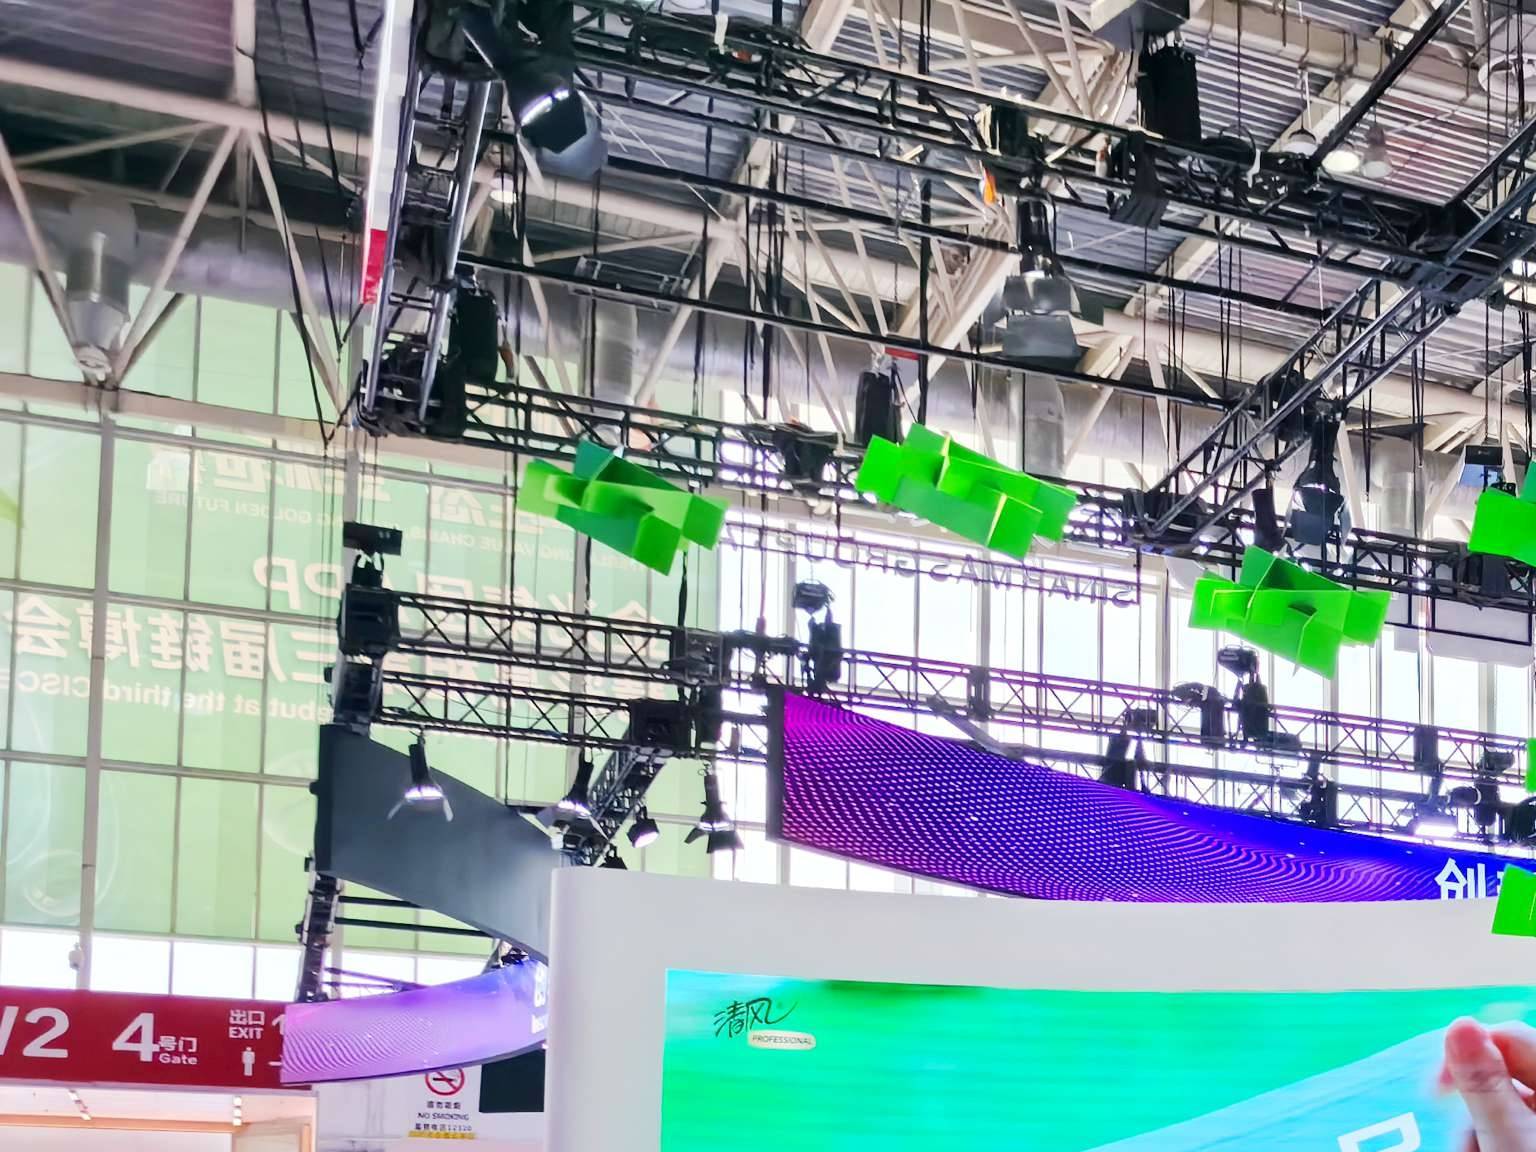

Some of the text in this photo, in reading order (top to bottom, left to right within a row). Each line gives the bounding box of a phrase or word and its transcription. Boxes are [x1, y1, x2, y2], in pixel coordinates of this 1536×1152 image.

[229, 1009, 265, 1026] 出口
[229, 1026, 264, 1039] EXIT
[157, 1036, 197, 1053] 号门
[158, 1053, 198, 1065] Gate
[417, 1112, 470, 1121] NO SMOKING
